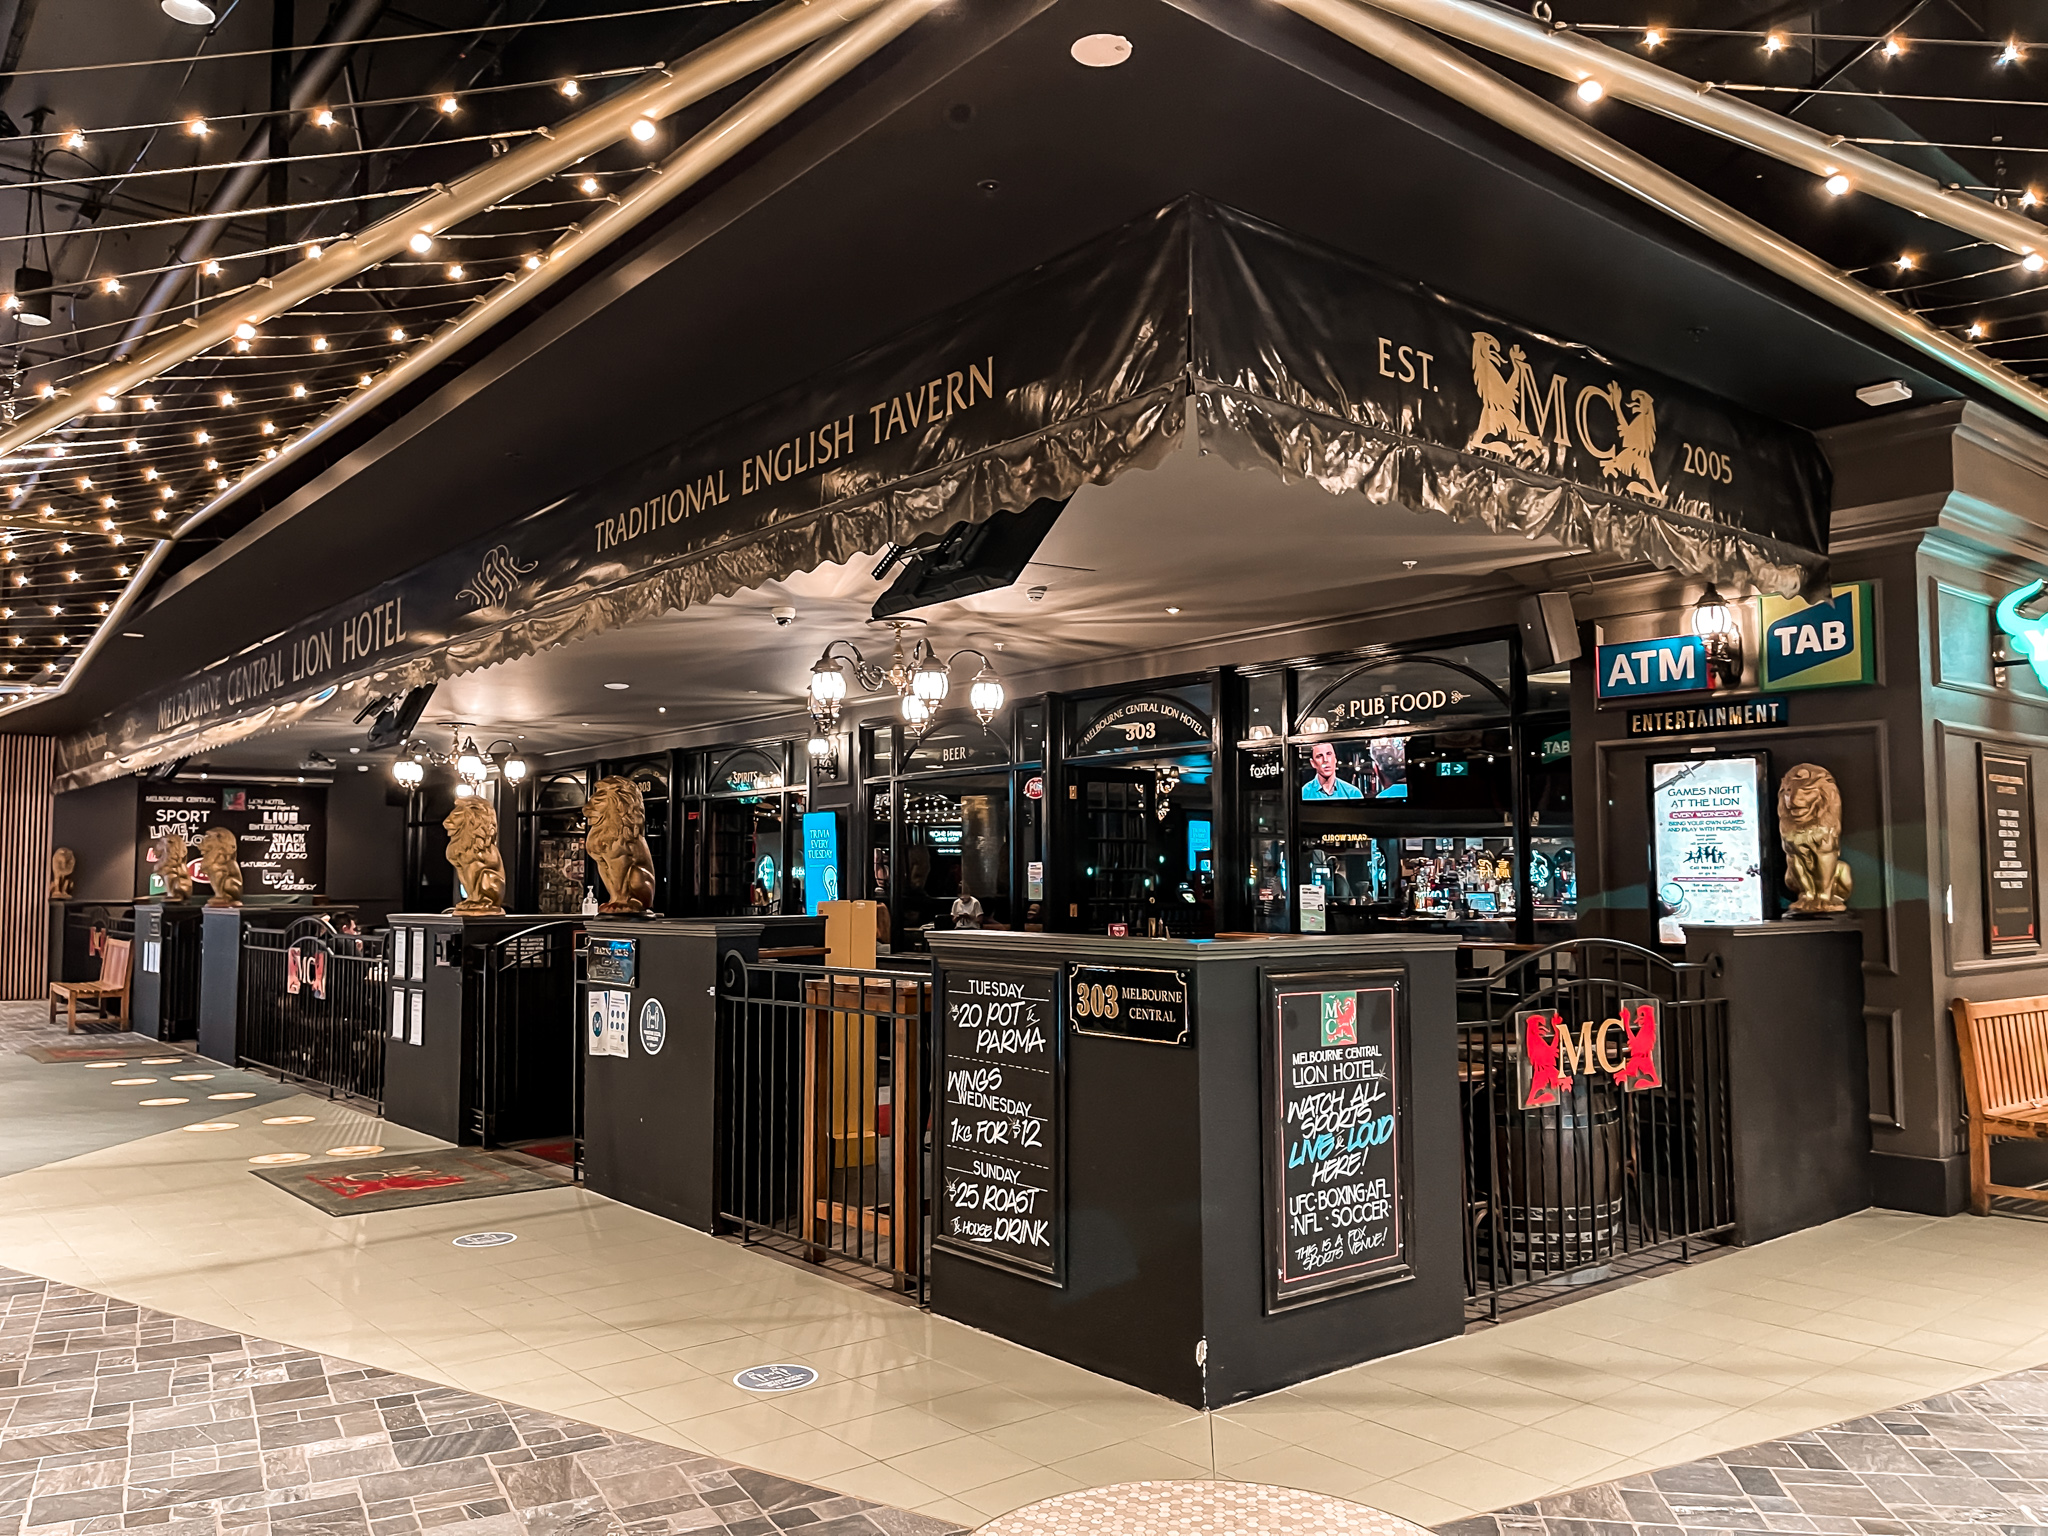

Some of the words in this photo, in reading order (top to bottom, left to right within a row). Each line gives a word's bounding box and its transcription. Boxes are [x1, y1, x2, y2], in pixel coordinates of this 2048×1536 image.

[1378, 337, 1439, 392] EST.
[1517, 359, 1617, 459] MC
[595, 470, 731, 552] TRADITIONAL
[741, 414, 855, 496] ENGLISH
[868, 356, 994, 444] TAVERN
[1682, 442, 1734, 484] 2005
[1774, 621, 1847, 656] TAB
[157, 676, 222, 732] MELBOURNE
[227, 650, 285, 706] CENTRAL
[292, 628, 333, 682] LION
[342, 597, 407, 663] HOTEL
[1607, 645, 1695, 688] ATM
[1350, 698, 1386, 717] PUB
[1391, 690, 1447, 713] FOOD
[1083, 708, 1124, 744] MELBOURNE
[1125, 703, 1159, 715] CENTRAL
[1160, 705, 1180, 719] LION
[1180, 713, 1204, 736] HOTEL
[1632, 703, 1780, 733] ENTERTAINMENT
[1126, 722, 1156, 741] 303
[943, 747, 967, 762] BEER
[1544, 740, 1570, 754] TAB
[733, 771, 758, 784] SPIRITS
[1250, 762, 1280, 778] foxtel
[1668, 787, 1706, 797] GAMES
[1709, 786, 1742, 795] NIGHT
[1671, 799, 1685, 808] AT
[1688, 799, 1710, 807] THE
[1713, 798, 1740, 806] LION
[156, 809, 211, 822] SPORT
[249, 823, 311, 831] ENTERTAINMENT
[1696, 810, 1740, 818] WEDNESDAY
[272, 833, 305, 843] SNACK
[810, 829, 830, 838] TRIVIA
[811, 839, 829, 848] EVERY
[269, 842, 306, 853] ATTACK
[808, 849, 832, 858] TUESDAY
[969, 980, 1025, 999] TUESDAY
[1077, 983, 1120, 1019] 303
[1121, 987, 1183, 1004] MELBOURNE
[950, 1002, 982, 1028] $20
[986, 1001, 1025, 1027] POT
[1129, 1007, 1176, 1023] CENTRAL
[976, 1027, 1046, 1053] PARMA
[1556, 1018, 1627, 1079] MC
[1292, 1048, 1343, 1065] MELBOURNE
[1345, 1045, 1382, 1060] CENTRAL
[948, 1068, 1002, 1092] WINGS
[1293, 1065, 1327, 1086] LION
[1333, 1060, 1381, 1082] HOTEL
[958, 1091, 1032, 1117] WEDNESDAY
[1287, 1088, 1345, 1123] WATCH
[1350, 1081, 1386, 1106] ALL
[976, 1120, 1009, 1144] FOR
[1012, 1119, 1042, 1148] $12
[1300, 1103, 1372, 1139] SPORTS
[1288, 1132, 1335, 1169] LIVE
[1347, 1114, 1395, 1152] LOUD
[973, 1161, 1021, 1185] SUNDAY
[1311, 1146, 1369, 1187] HERE!
[948, 1182, 979, 1209] $25
[983, 1188, 1040, 1214] ROAST
[963, 1223, 992, 1238] HOUSE
[994, 1217, 1050, 1247] DRINK
[1295, 1243, 1318, 1260] THIS
[1322, 1238, 1332, 1252] IS
[1334, 1234, 1343, 1247] A
[1348, 1225, 1367, 1242] FOX
[1303, 1247, 1343, 1271] SPORTS
[1348, 1227, 1388, 1255] VENUE!
